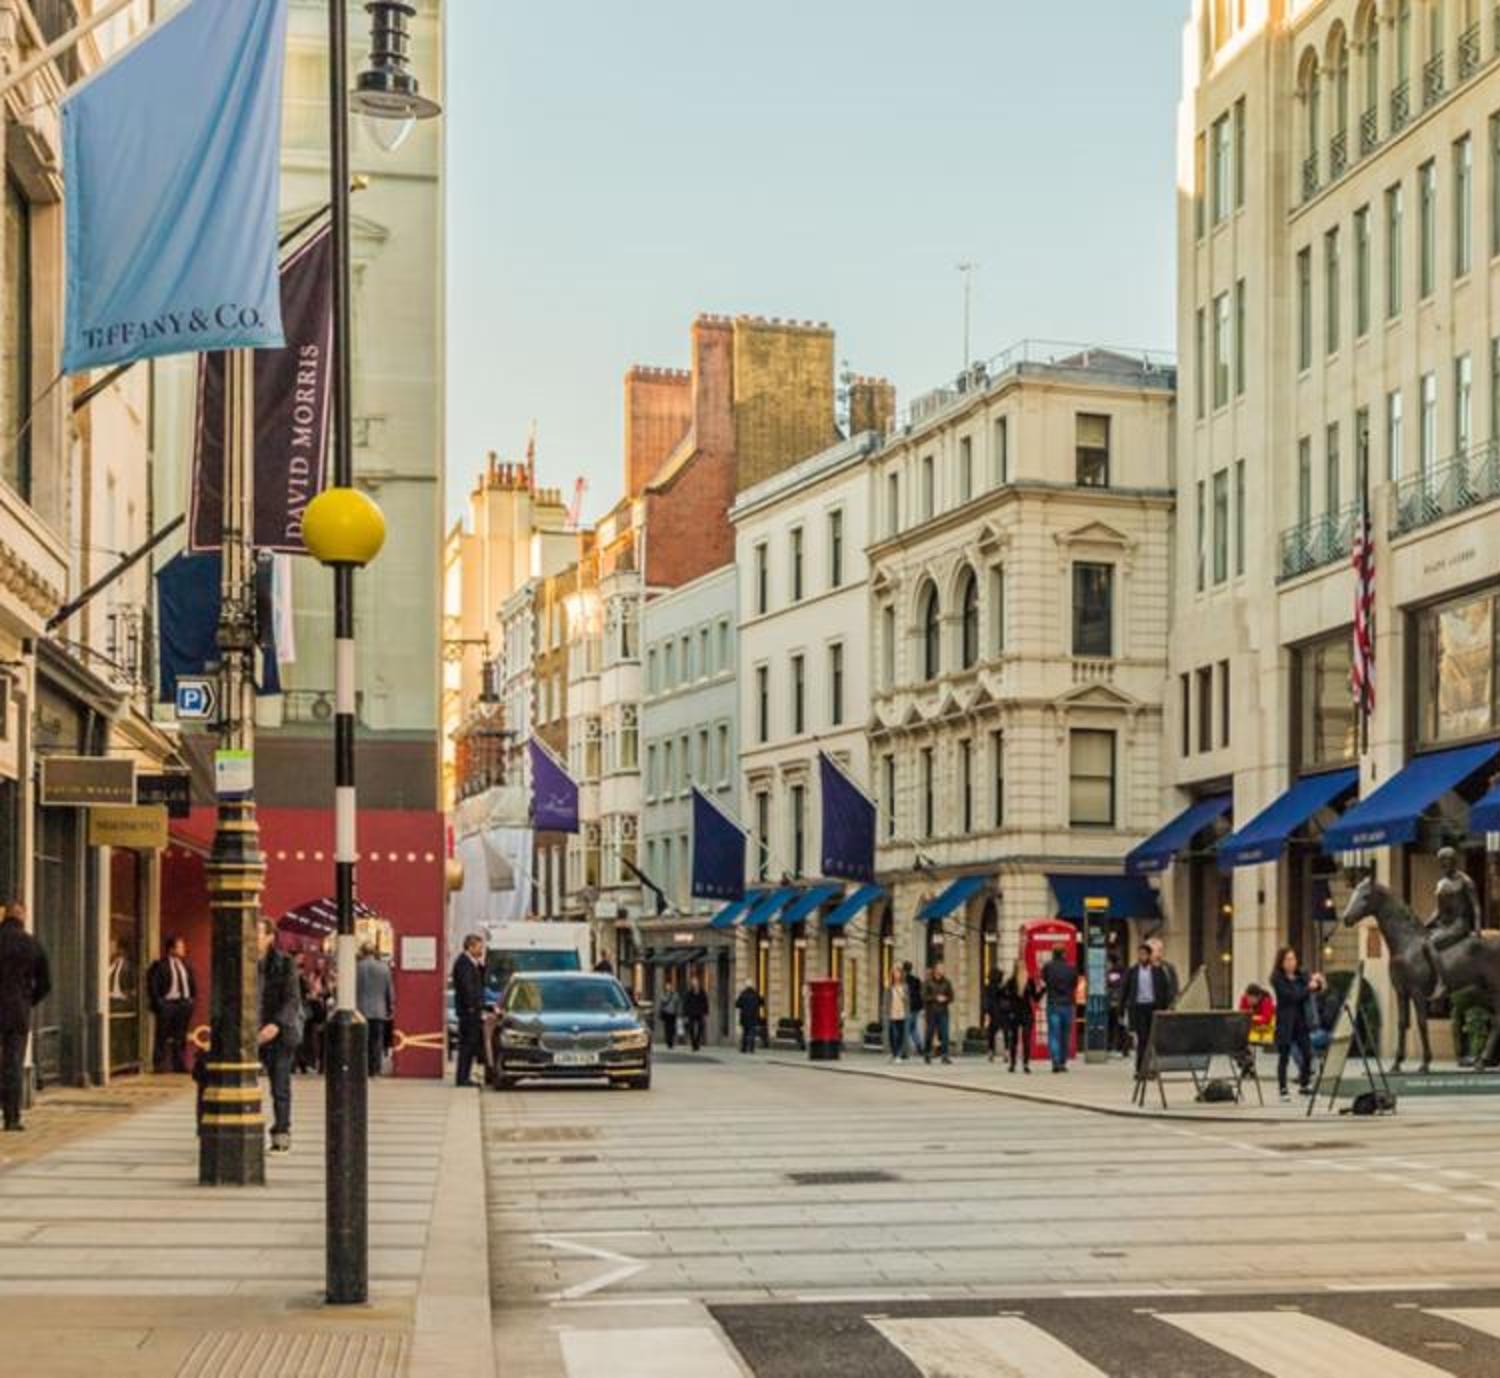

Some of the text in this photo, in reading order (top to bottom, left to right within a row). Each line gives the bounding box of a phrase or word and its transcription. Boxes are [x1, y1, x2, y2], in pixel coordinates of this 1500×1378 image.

[82, 309, 185, 349] TIFFANY
[188, 304, 209, 332] &
[285, 344, 320, 540] DAVID MORRIS
[184, 690, 199, 708] P
